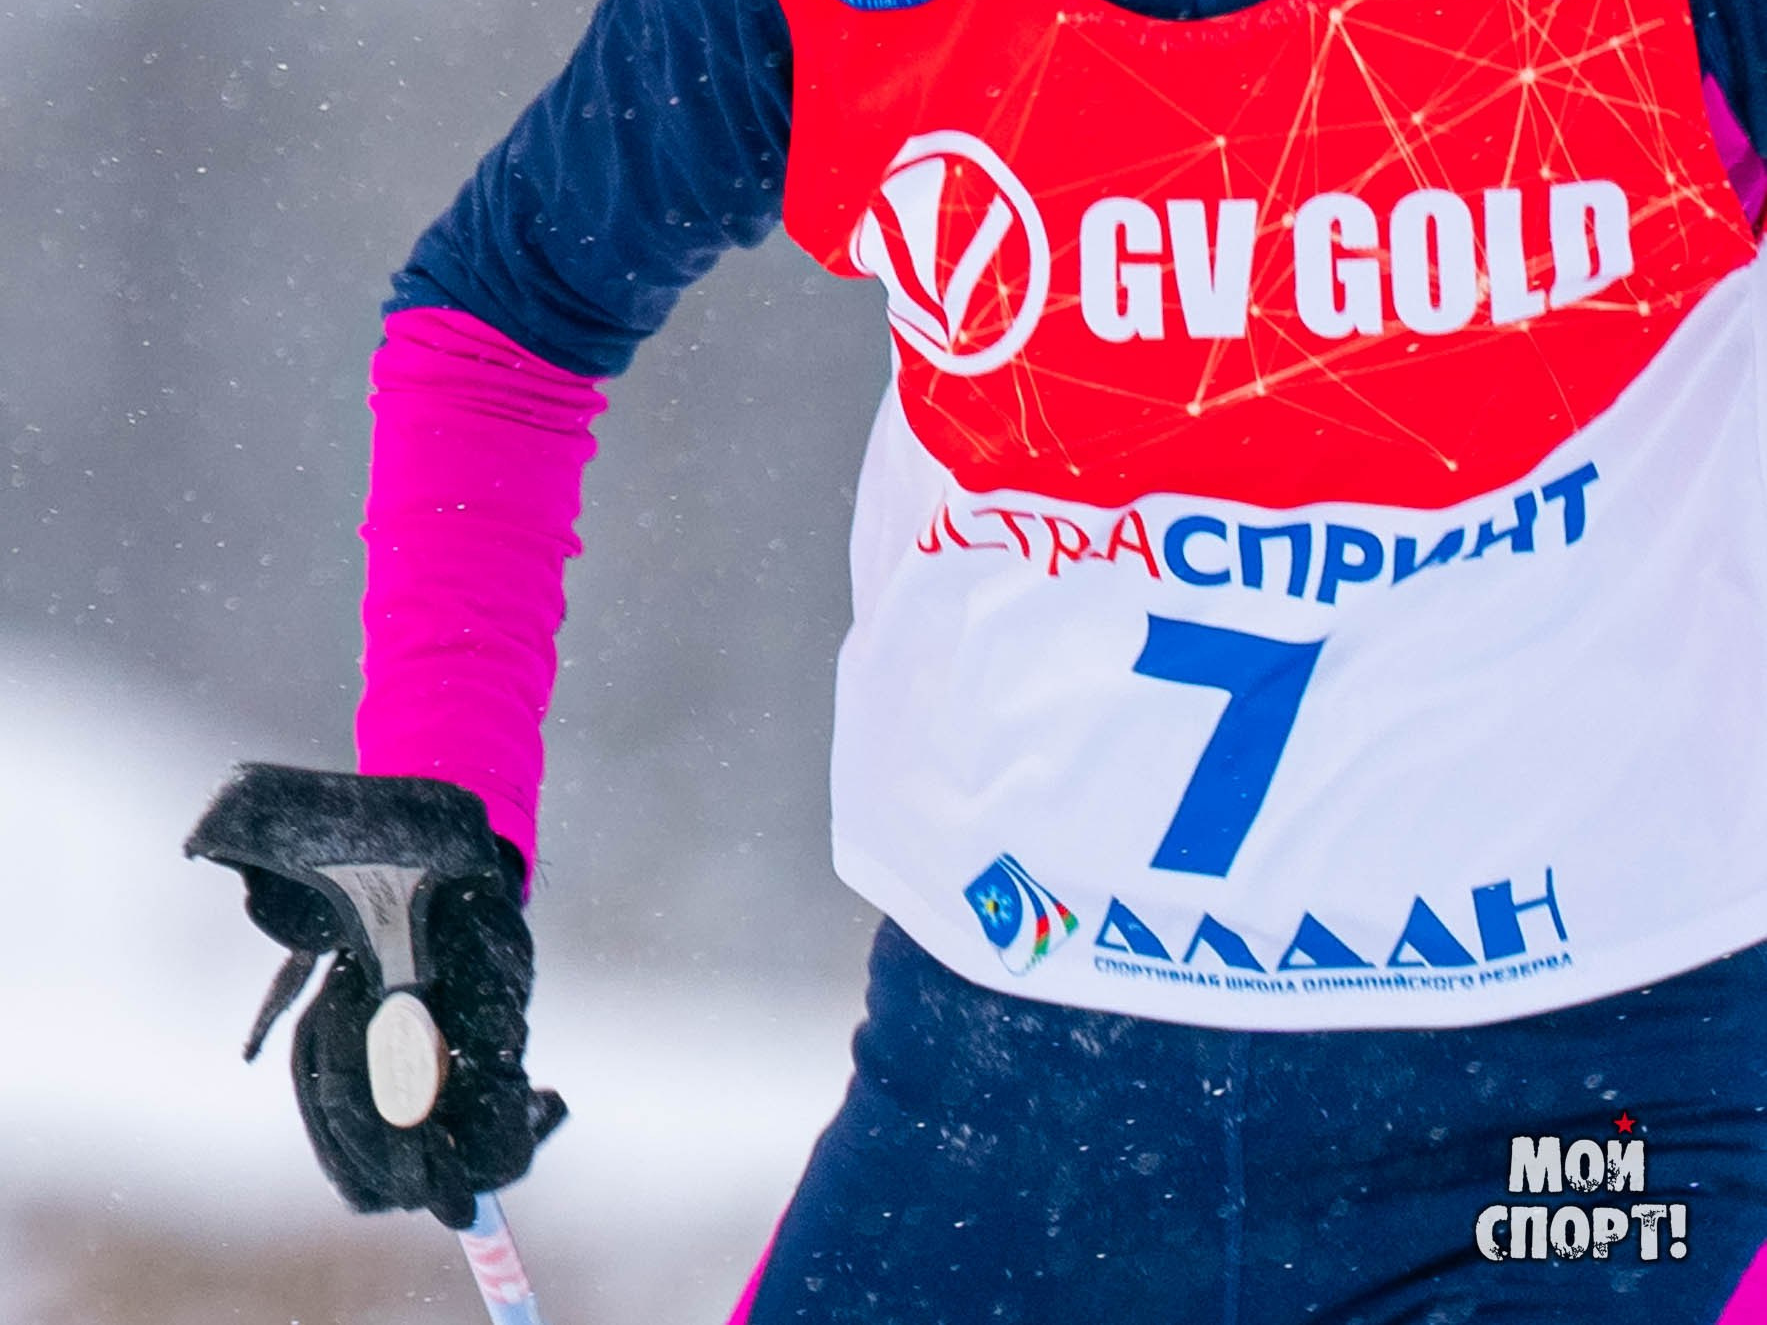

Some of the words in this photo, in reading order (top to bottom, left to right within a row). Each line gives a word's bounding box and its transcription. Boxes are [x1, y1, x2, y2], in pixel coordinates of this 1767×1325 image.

[1079, 196, 1257, 342] GV
[1293, 180, 1634, 338] GOLD
[1132, 612, 1327, 878] 7
[1094, 955, 1221, 989] СПОРТИВНАЯ
[1225, 975, 1298, 995] ШКОЛА
[1302, 971, 1476, 993] ОЛИМПИЙСКОГО
[1479, 952, 1573, 987] РЕЗЕРВА
